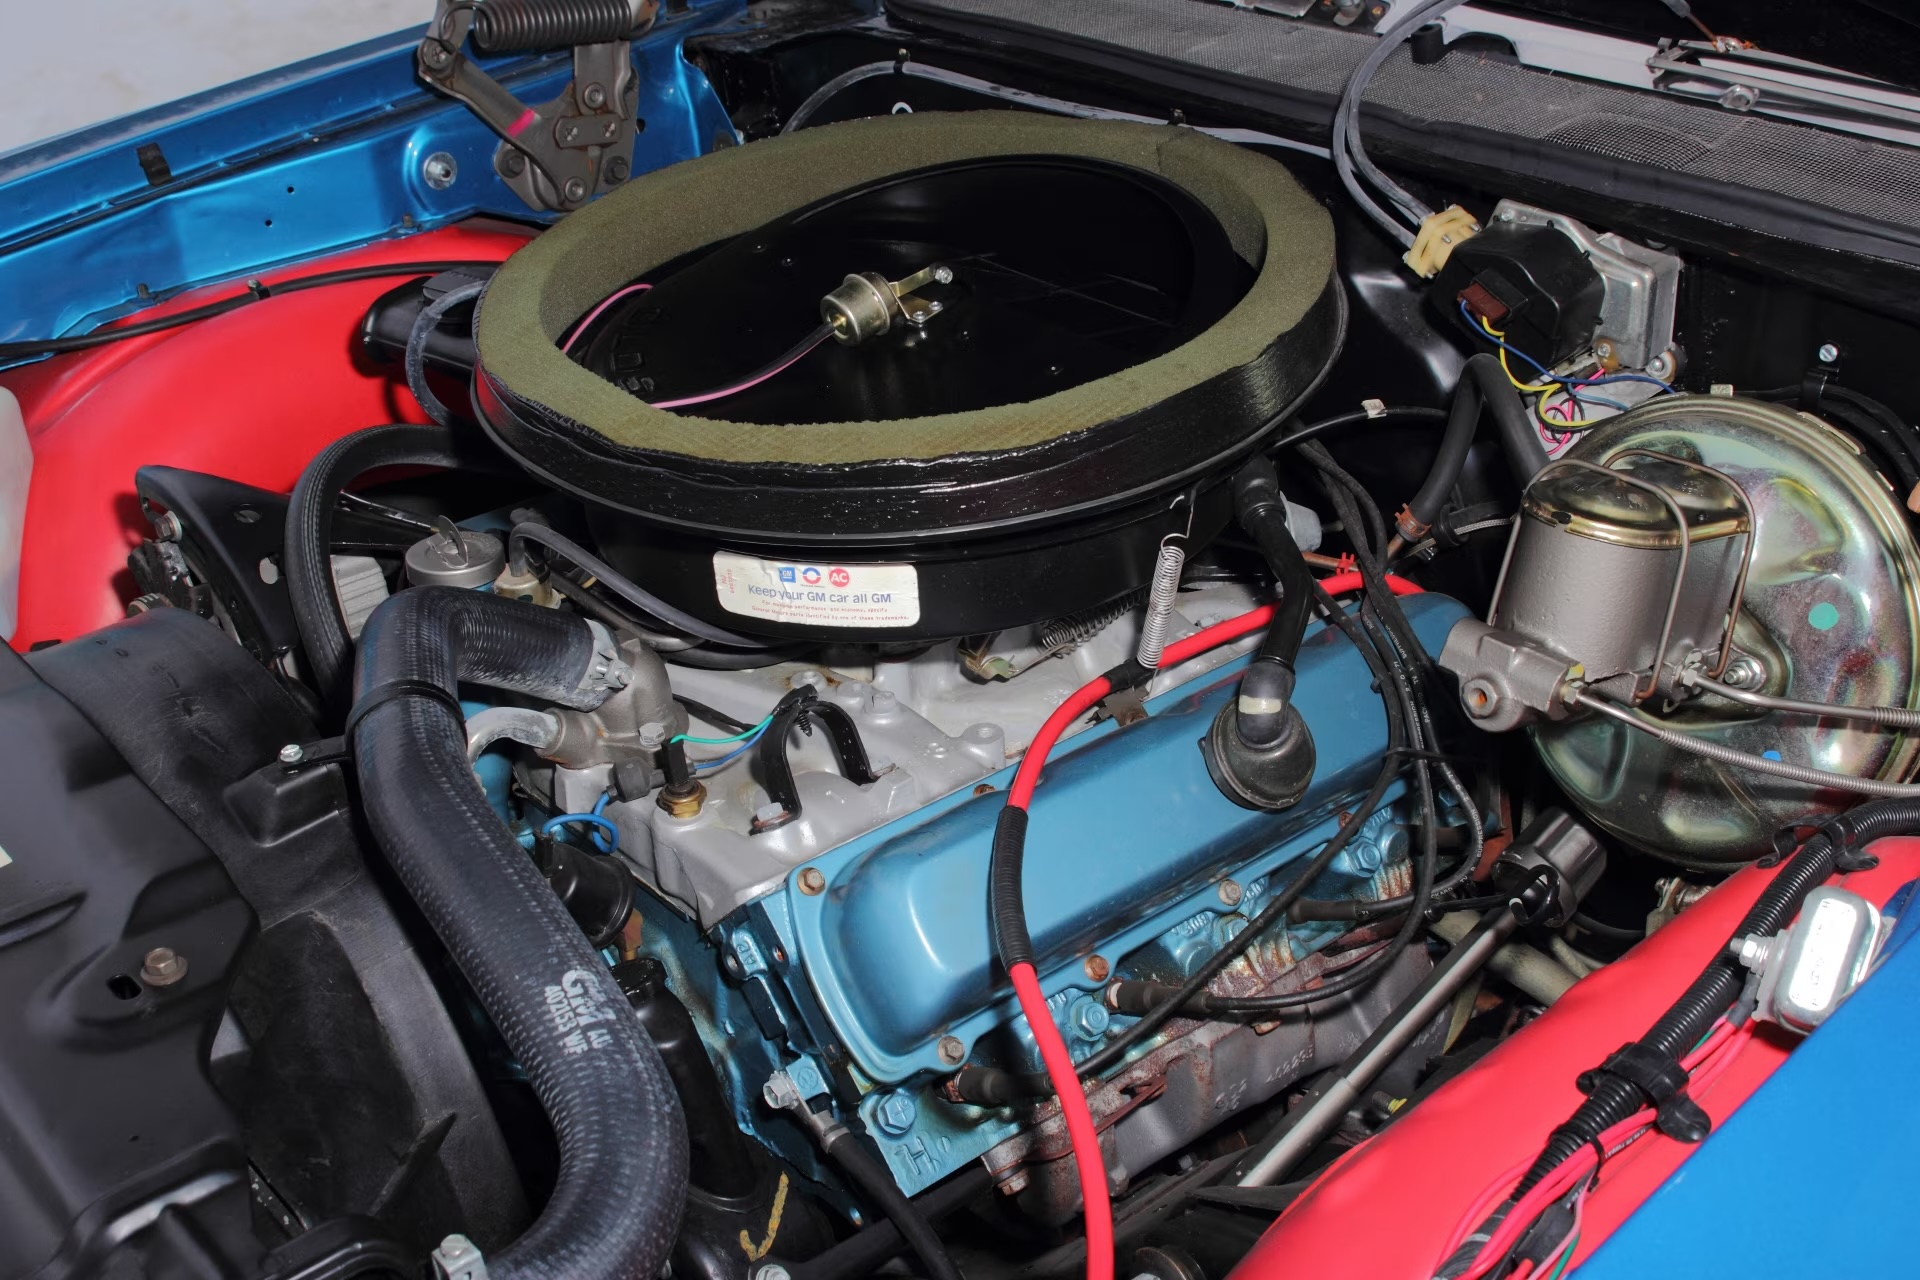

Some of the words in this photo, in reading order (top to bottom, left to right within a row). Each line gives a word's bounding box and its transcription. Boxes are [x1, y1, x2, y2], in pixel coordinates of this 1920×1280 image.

[782, 569, 793, 577] GM
[830, 572, 848, 583] AC
[748, 584, 777, 599] Keep
[778, 590, 804, 600] your
[806, 591, 826, 602] GM
[829, 593, 849, 603] car
[852, 593, 868, 604] all
[871, 593, 892, 603] GM
[1471, 808, 1484, 858] SUPPRESSION
[544, 985, 578, 1032] 402153
[561, 969, 617, 1027] GM
